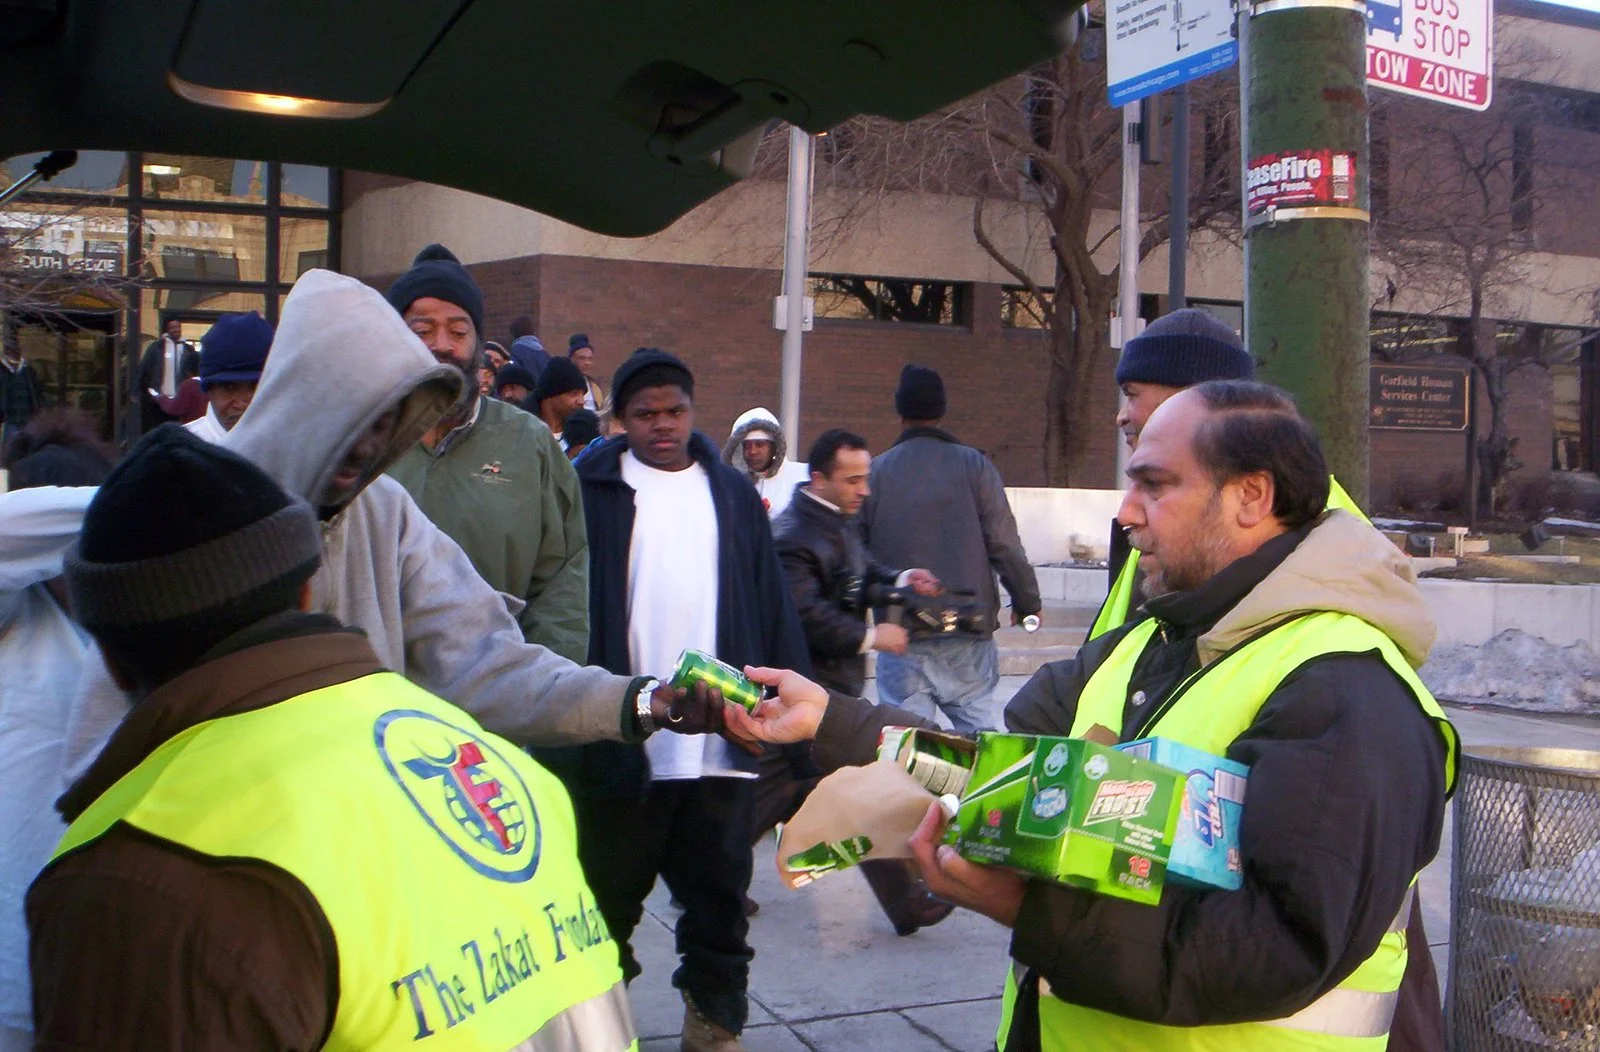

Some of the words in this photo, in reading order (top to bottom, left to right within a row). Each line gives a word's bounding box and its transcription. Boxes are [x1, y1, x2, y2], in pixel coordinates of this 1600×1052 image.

[1414, 17, 1470, 59] STOP
[1366, 48, 1409, 83] TOW
[1420, 61, 1477, 101] ZONE
[1379, 374, 1418, 387] Garfield
[1421, 390, 1452, 403] Center
[1128, 855, 1151, 878] 12
[1118, 872, 1152, 890] PACK
[391, 963, 475, 1041] The
[460, 926, 540, 1004] Zakat
